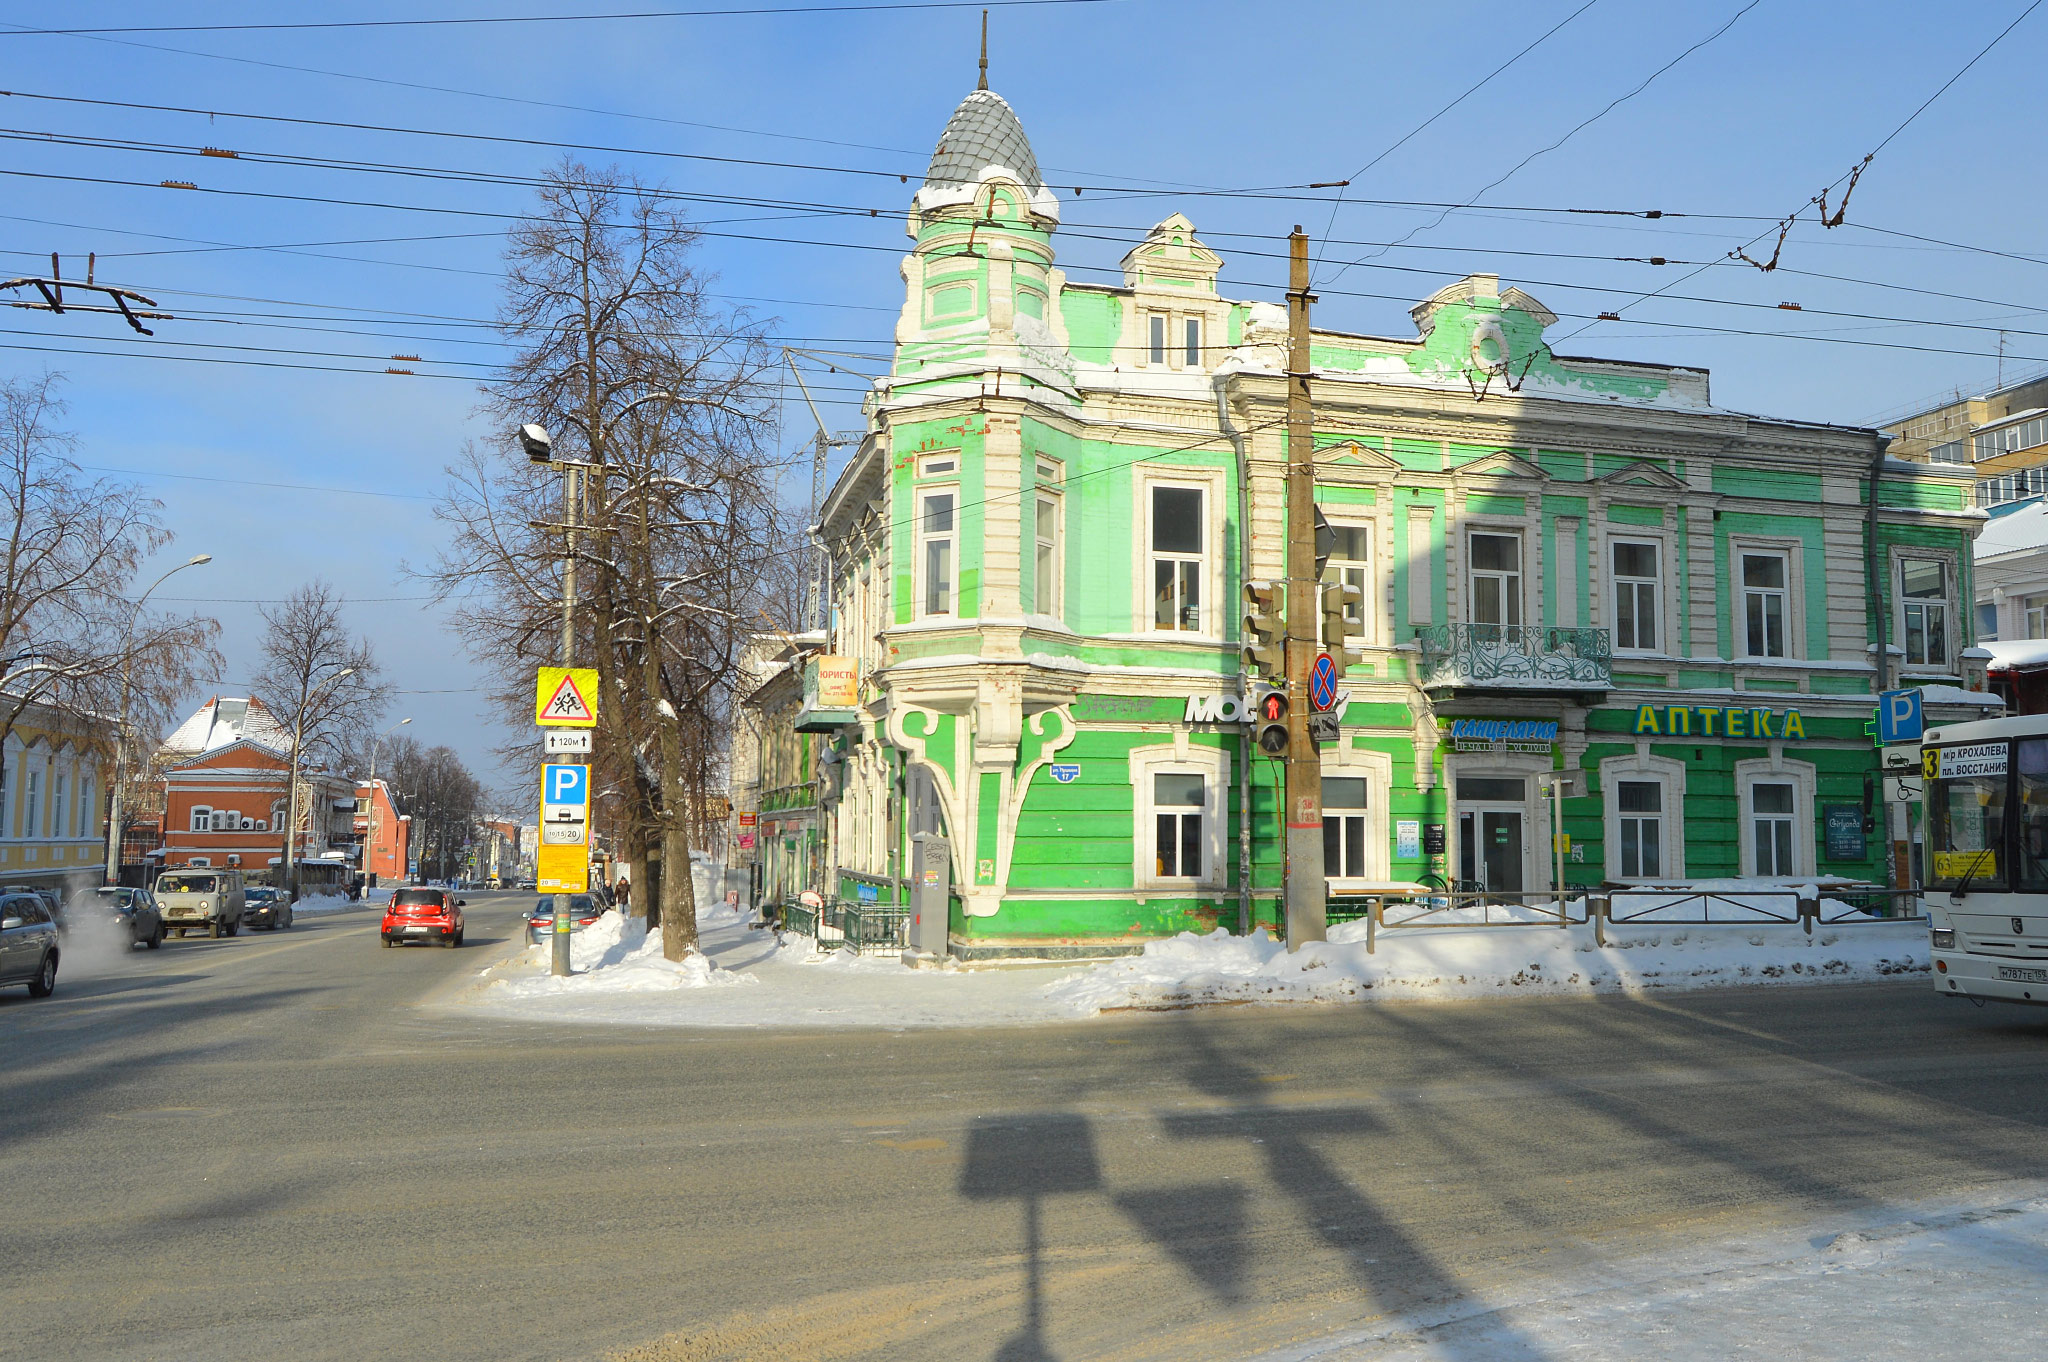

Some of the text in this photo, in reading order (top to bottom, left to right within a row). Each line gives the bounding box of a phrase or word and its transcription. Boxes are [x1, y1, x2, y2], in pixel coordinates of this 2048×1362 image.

[820, 670, 857, 679] ЮРИСТЫ
[1632, 703, 1809, 741] АПТЕКА
[1890, 696, 1914, 736] P
[1451, 719, 1559, 742] КАНЦЕЛЯРИЯ
[1957, 744, 2007, 759] КРОХАЛЕВА
[1942, 761, 2007, 776] пл. ВОССТАНИЯ
[555, 769, 578, 800] P
[1937, 857, 1951, 871] 63
